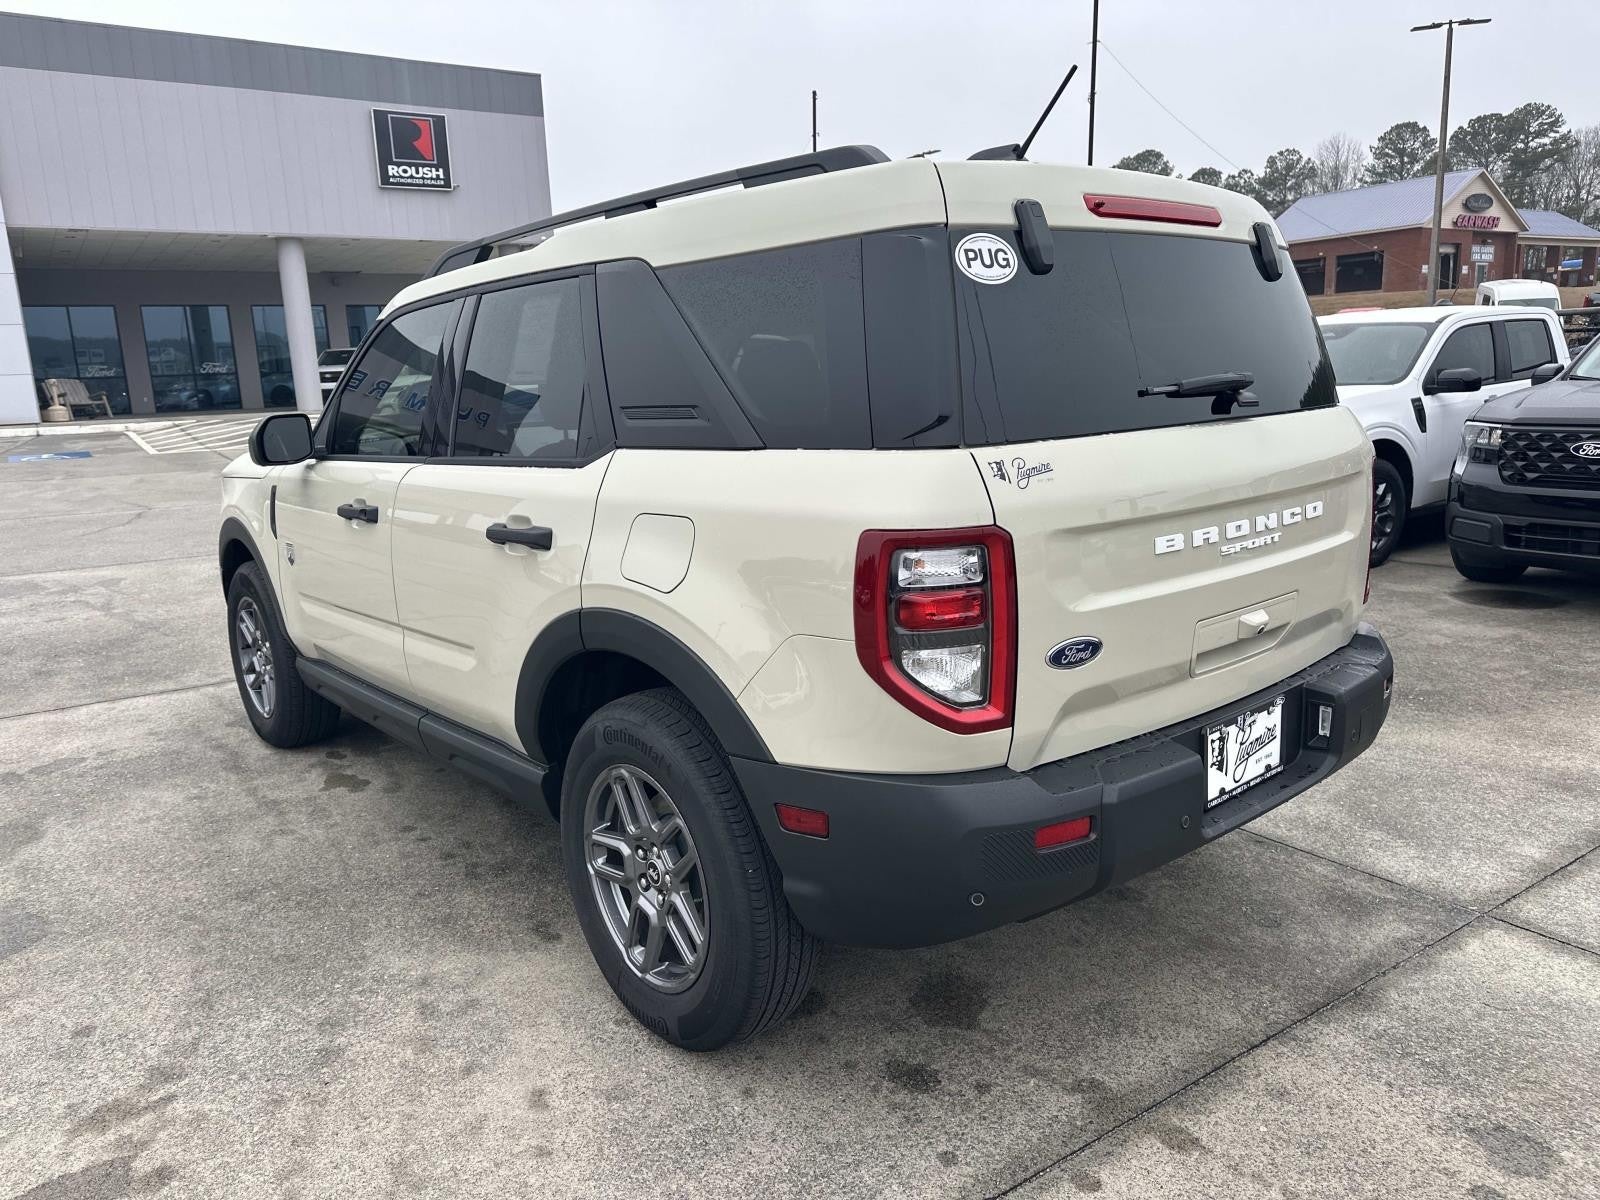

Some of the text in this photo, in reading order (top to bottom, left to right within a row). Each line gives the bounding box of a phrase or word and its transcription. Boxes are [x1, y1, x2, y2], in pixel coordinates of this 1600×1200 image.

[387, 165, 445, 179] ROUSH
[1456, 214, 1500, 229] CARWASH
[964, 247, 1011, 269] PUG
[200, 361, 228, 374] Ford
[1580, 443, 1600, 456] For
[1012, 457, 1053, 490] Pugmire
[1154, 501, 1323, 555] BRONCO
[1220, 532, 1282, 556] SPORT
[1061, 643, 1093, 664] Ford
[603, 725, 665, 769] Continental
